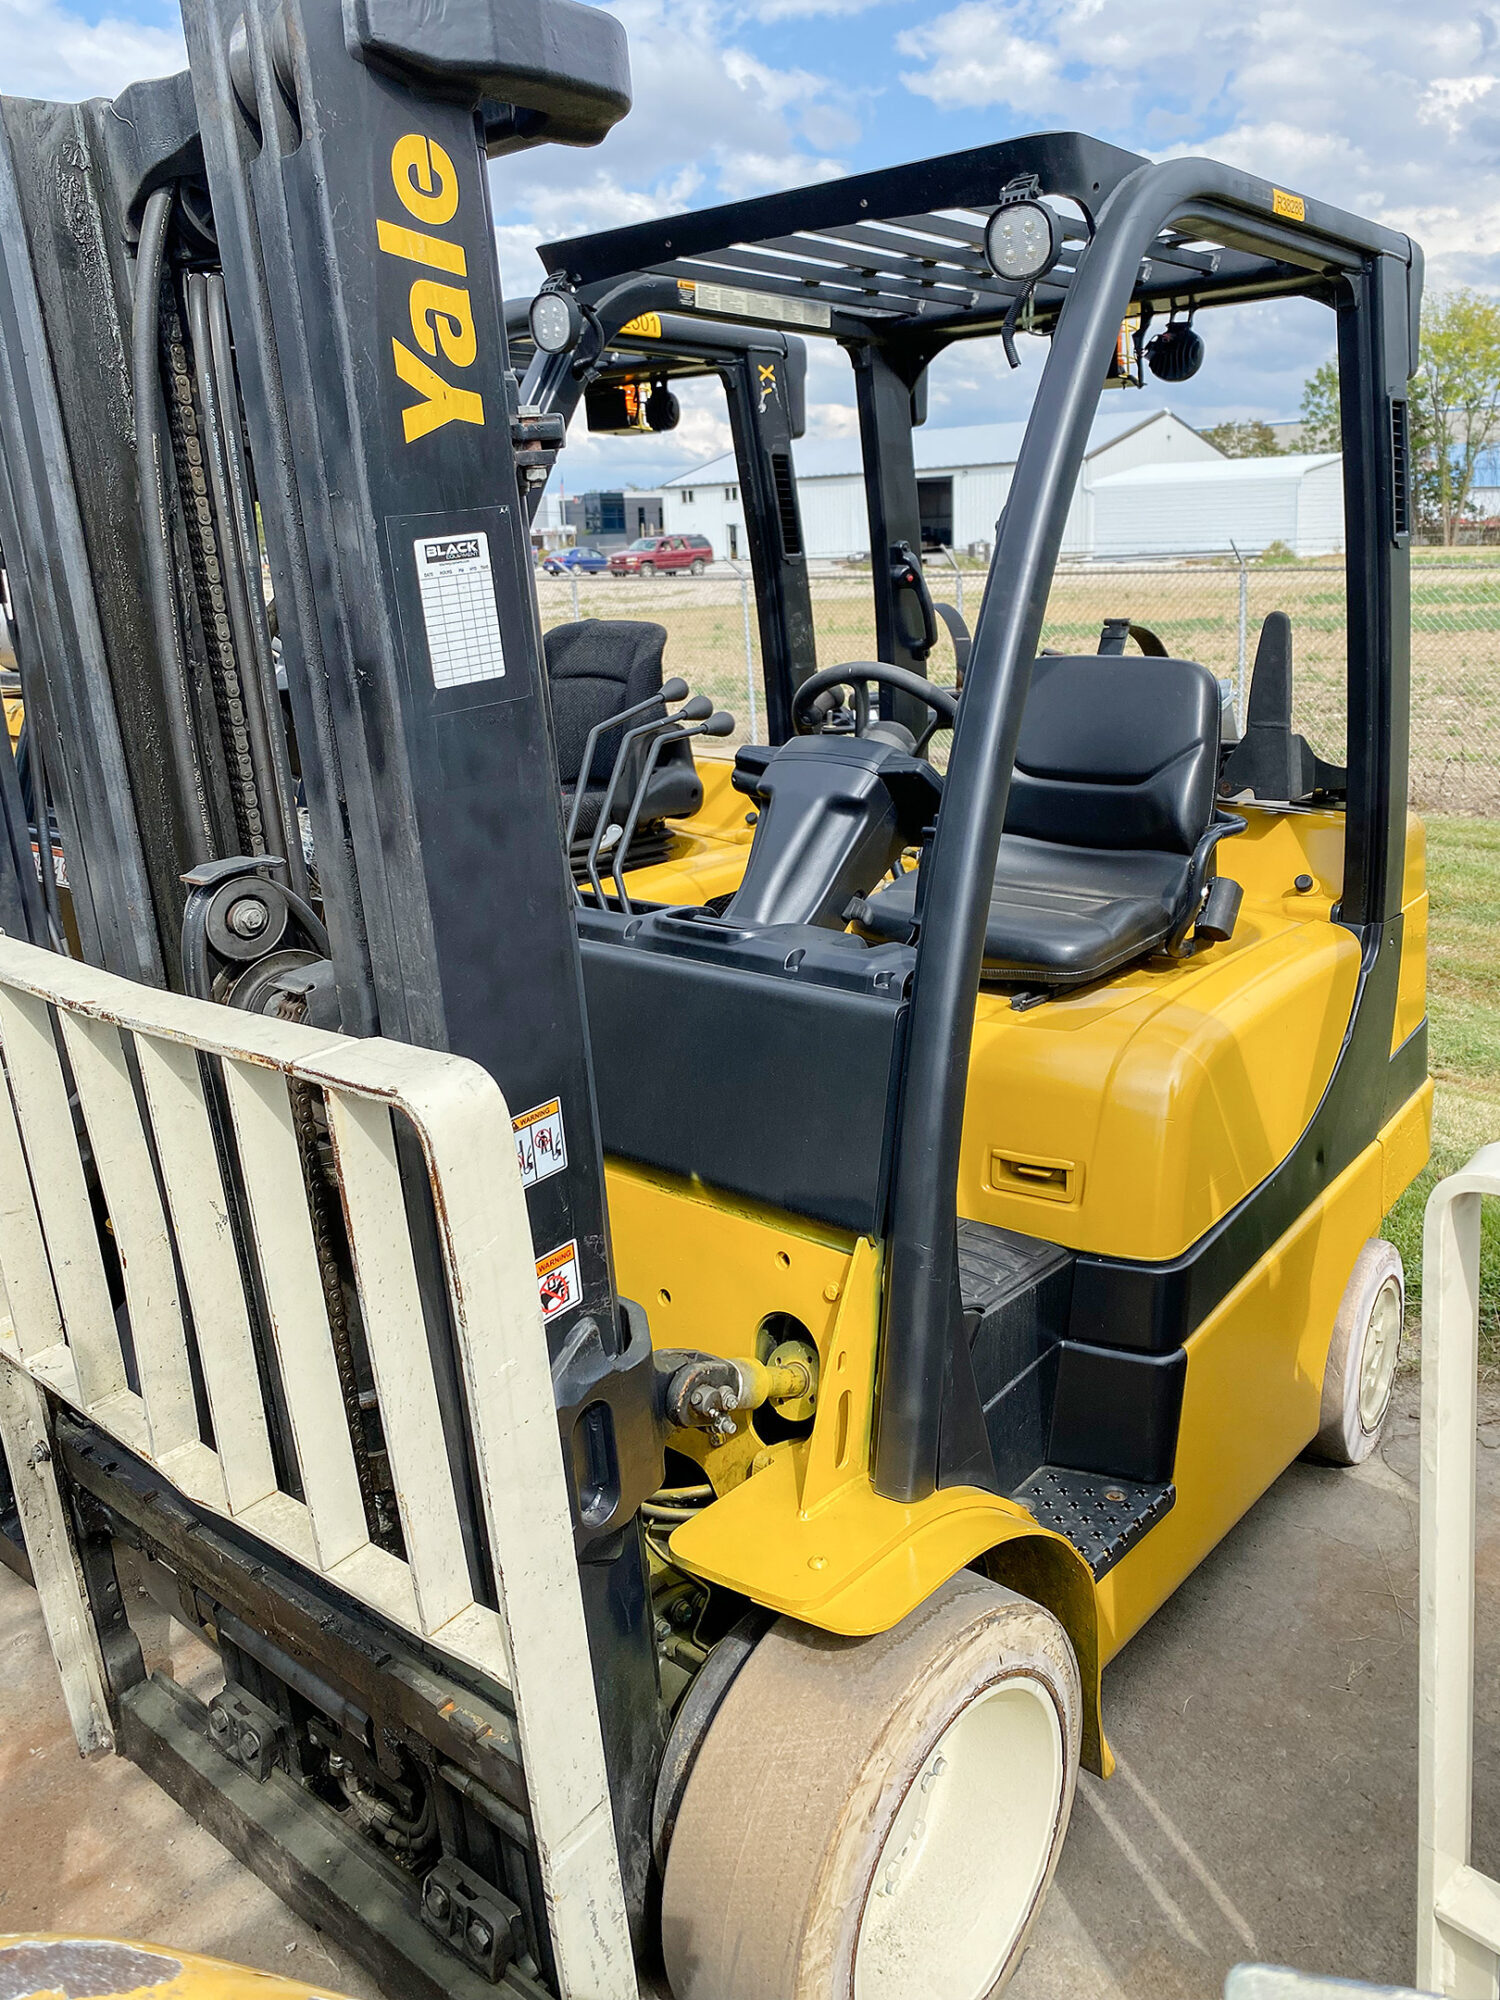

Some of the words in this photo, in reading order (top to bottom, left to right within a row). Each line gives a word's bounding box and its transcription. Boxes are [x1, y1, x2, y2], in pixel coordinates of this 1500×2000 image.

[376, 133, 485, 444] Yale
[426, 541, 478, 557] BLACK
[520, 1107, 551, 1126] WARNING
[538, 1249, 572, 1273] WARNING
